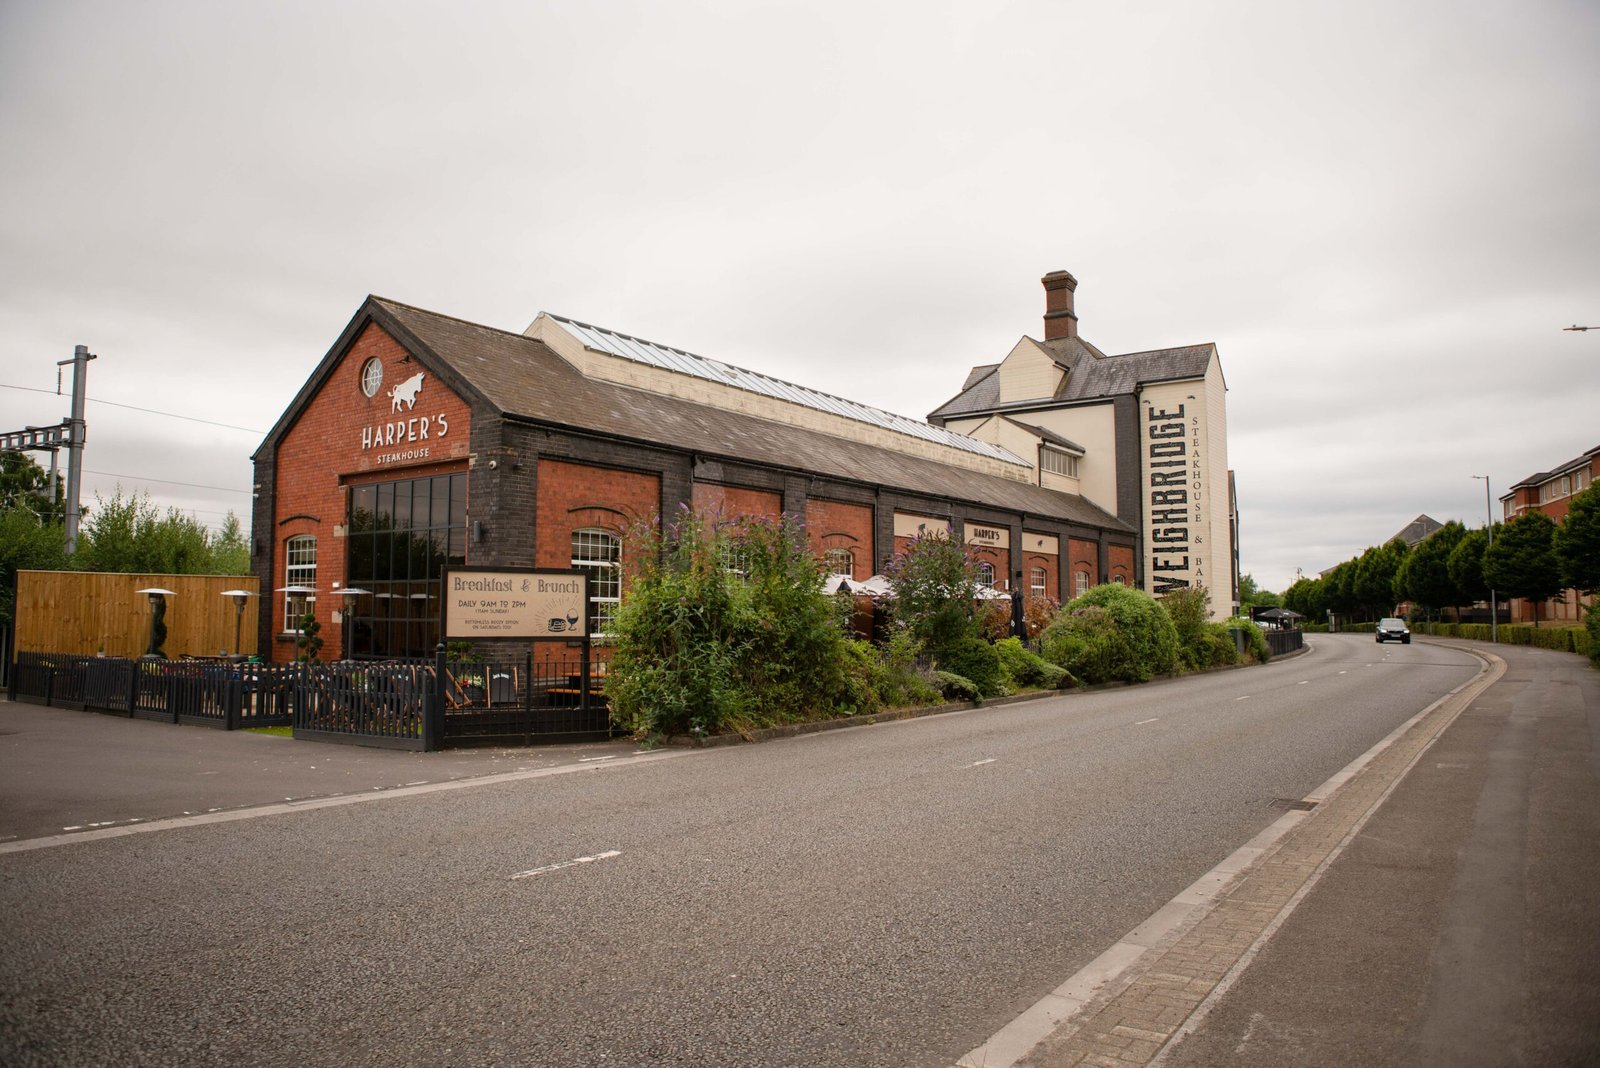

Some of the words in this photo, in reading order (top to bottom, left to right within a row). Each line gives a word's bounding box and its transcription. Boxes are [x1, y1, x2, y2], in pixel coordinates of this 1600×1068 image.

[361, 413, 448, 449] HARPER'S
[377, 448, 430, 464] STEAKHOUSE
[1192, 416, 1202, 523] STEAKHOUSE
[974, 528, 1000, 540] HARPER'S
[1194, 535, 1203, 544] &
[454, 577, 513, 592] Breakfast
[520, 579, 532, 592] &
[537, 579, 579, 594] Brunch
[458, 600, 477, 608] DAILY
[480, 600, 497, 608] 9AM
[500, 600, 509, 608] TO
[512, 600, 526, 608] 2PM
